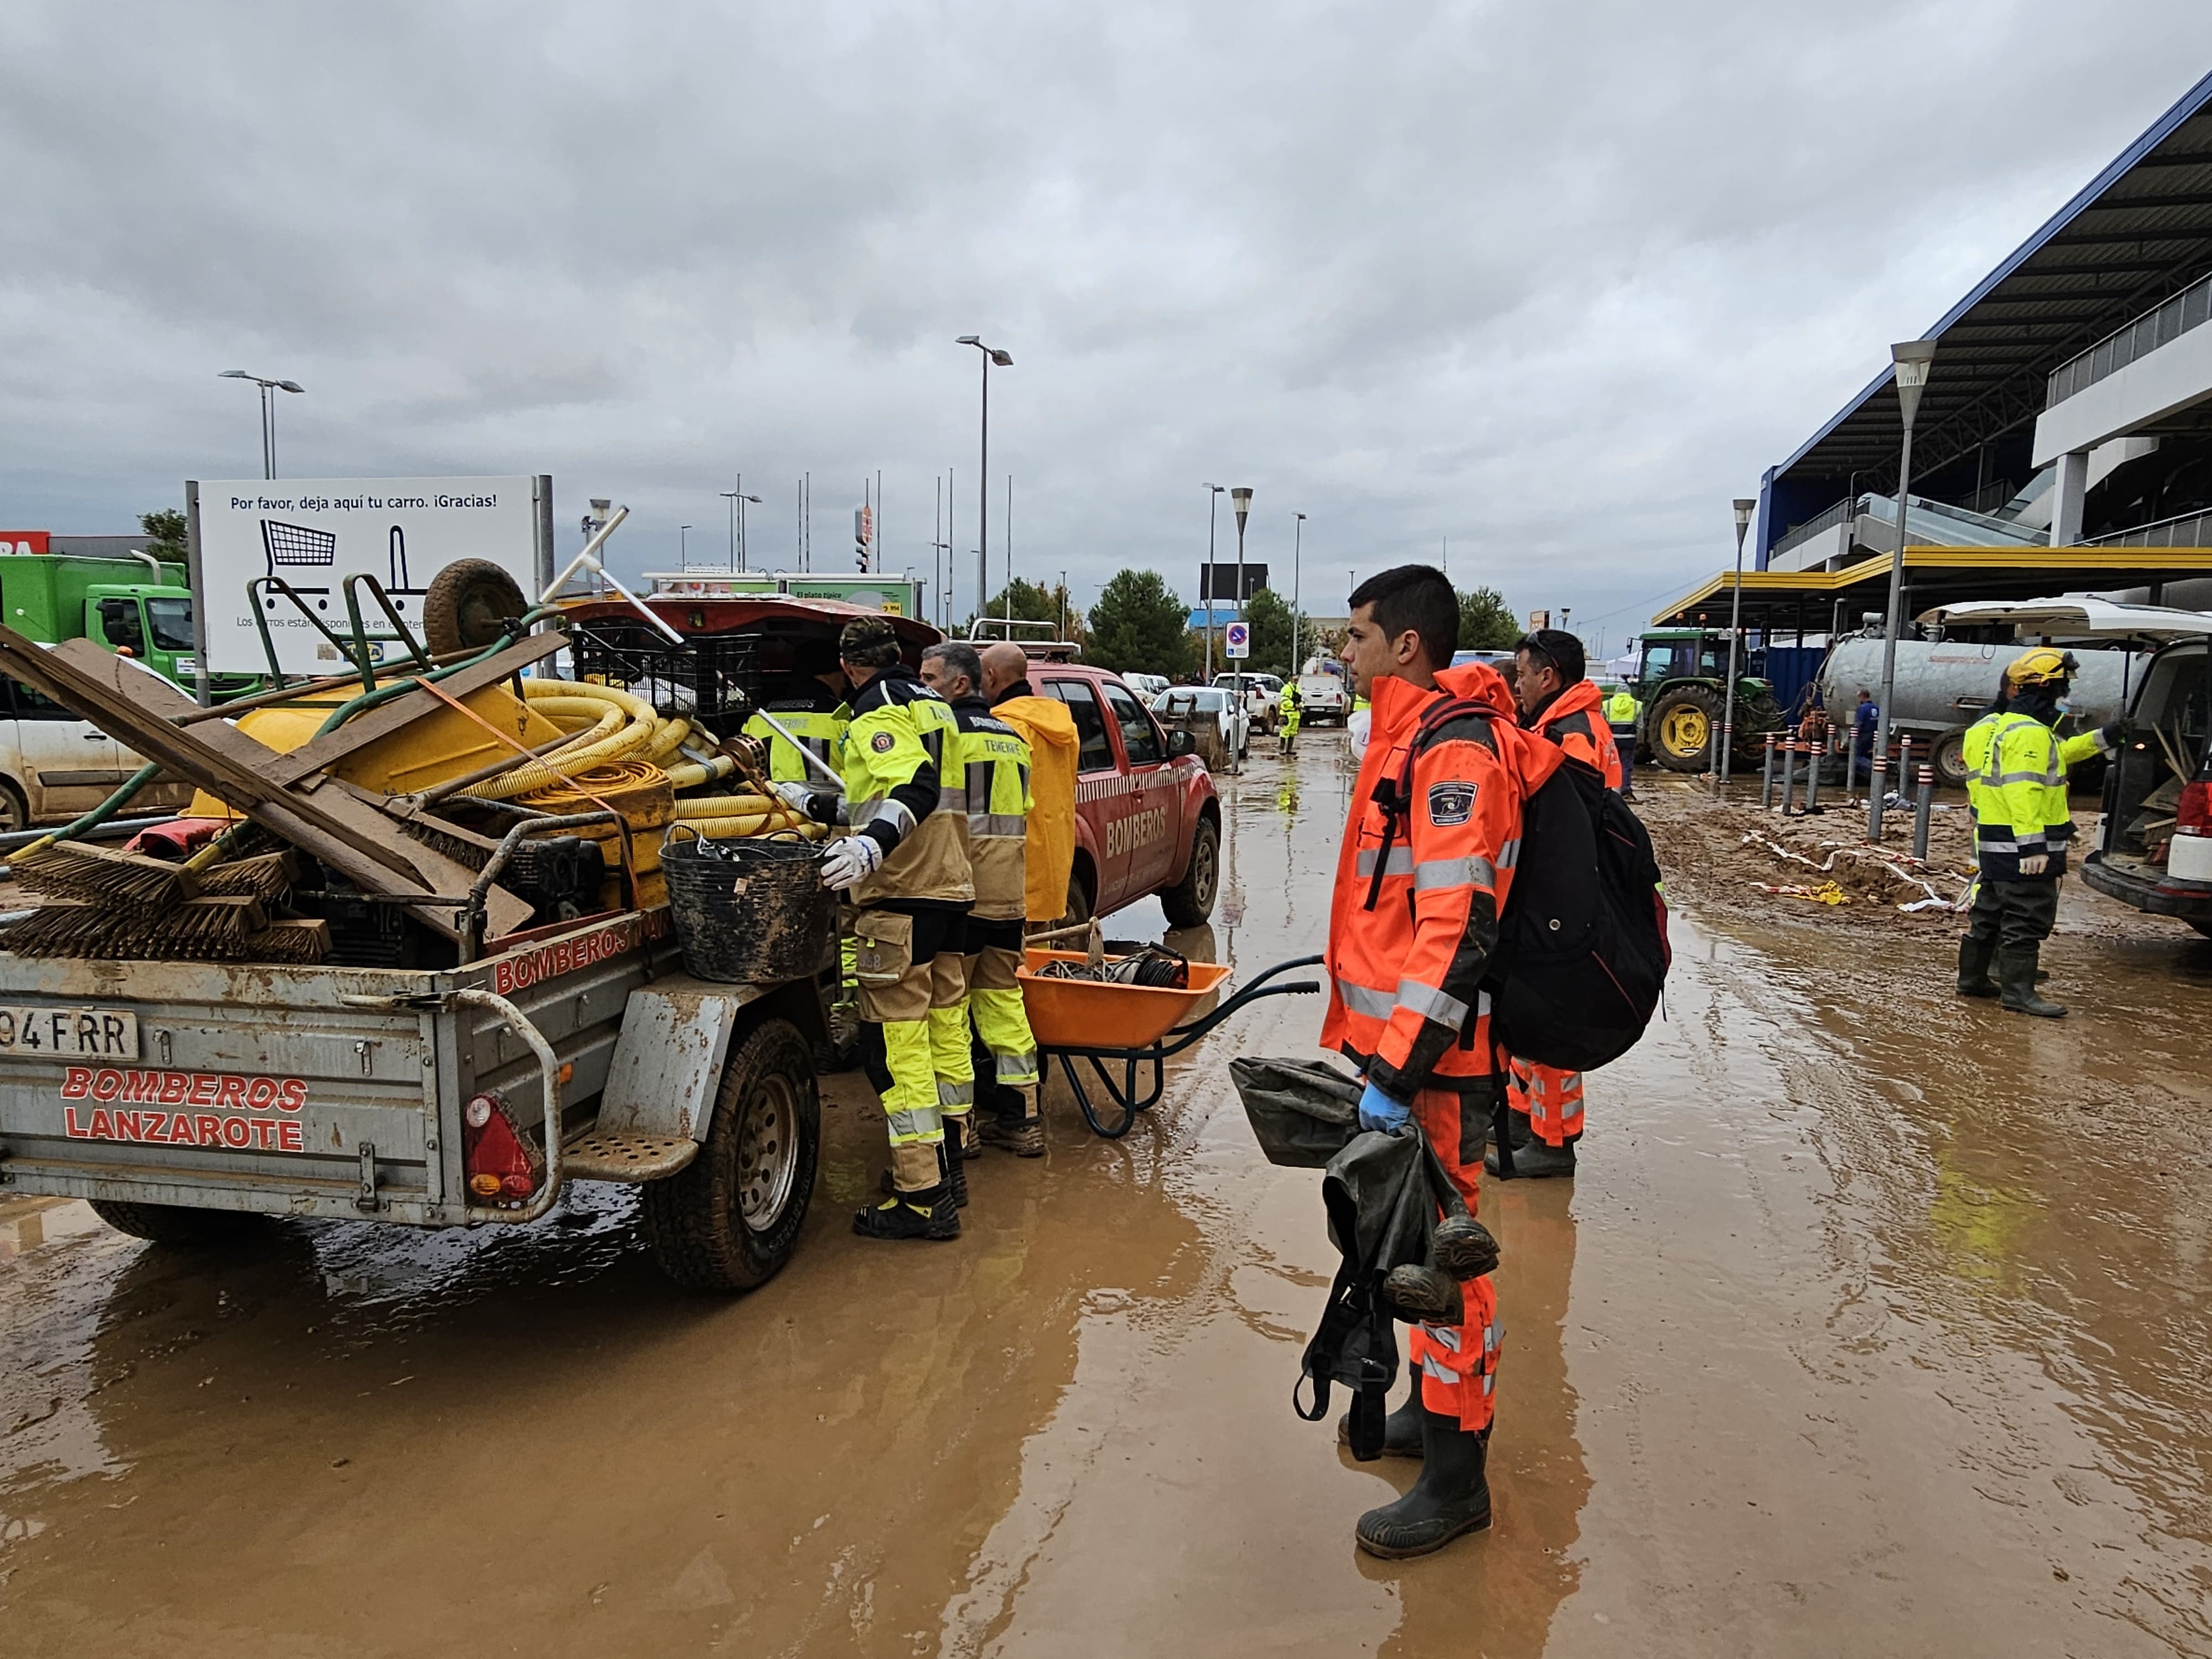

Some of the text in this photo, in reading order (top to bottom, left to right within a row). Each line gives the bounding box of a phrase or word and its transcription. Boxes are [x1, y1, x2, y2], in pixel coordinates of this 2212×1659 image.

[231, 494, 496, 512] Por favor, deja aquí tu carro. ¡Gracias!
[237, 617, 253, 627] Los
[373, 620, 385, 628] en
[1107, 806, 1165, 859] BOMBEROS
[495, 922, 629, 995] BOMBEROS
[61, 1067, 309, 1113] BOMBEROS
[64, 1107, 304, 1152] LANZAROTE
